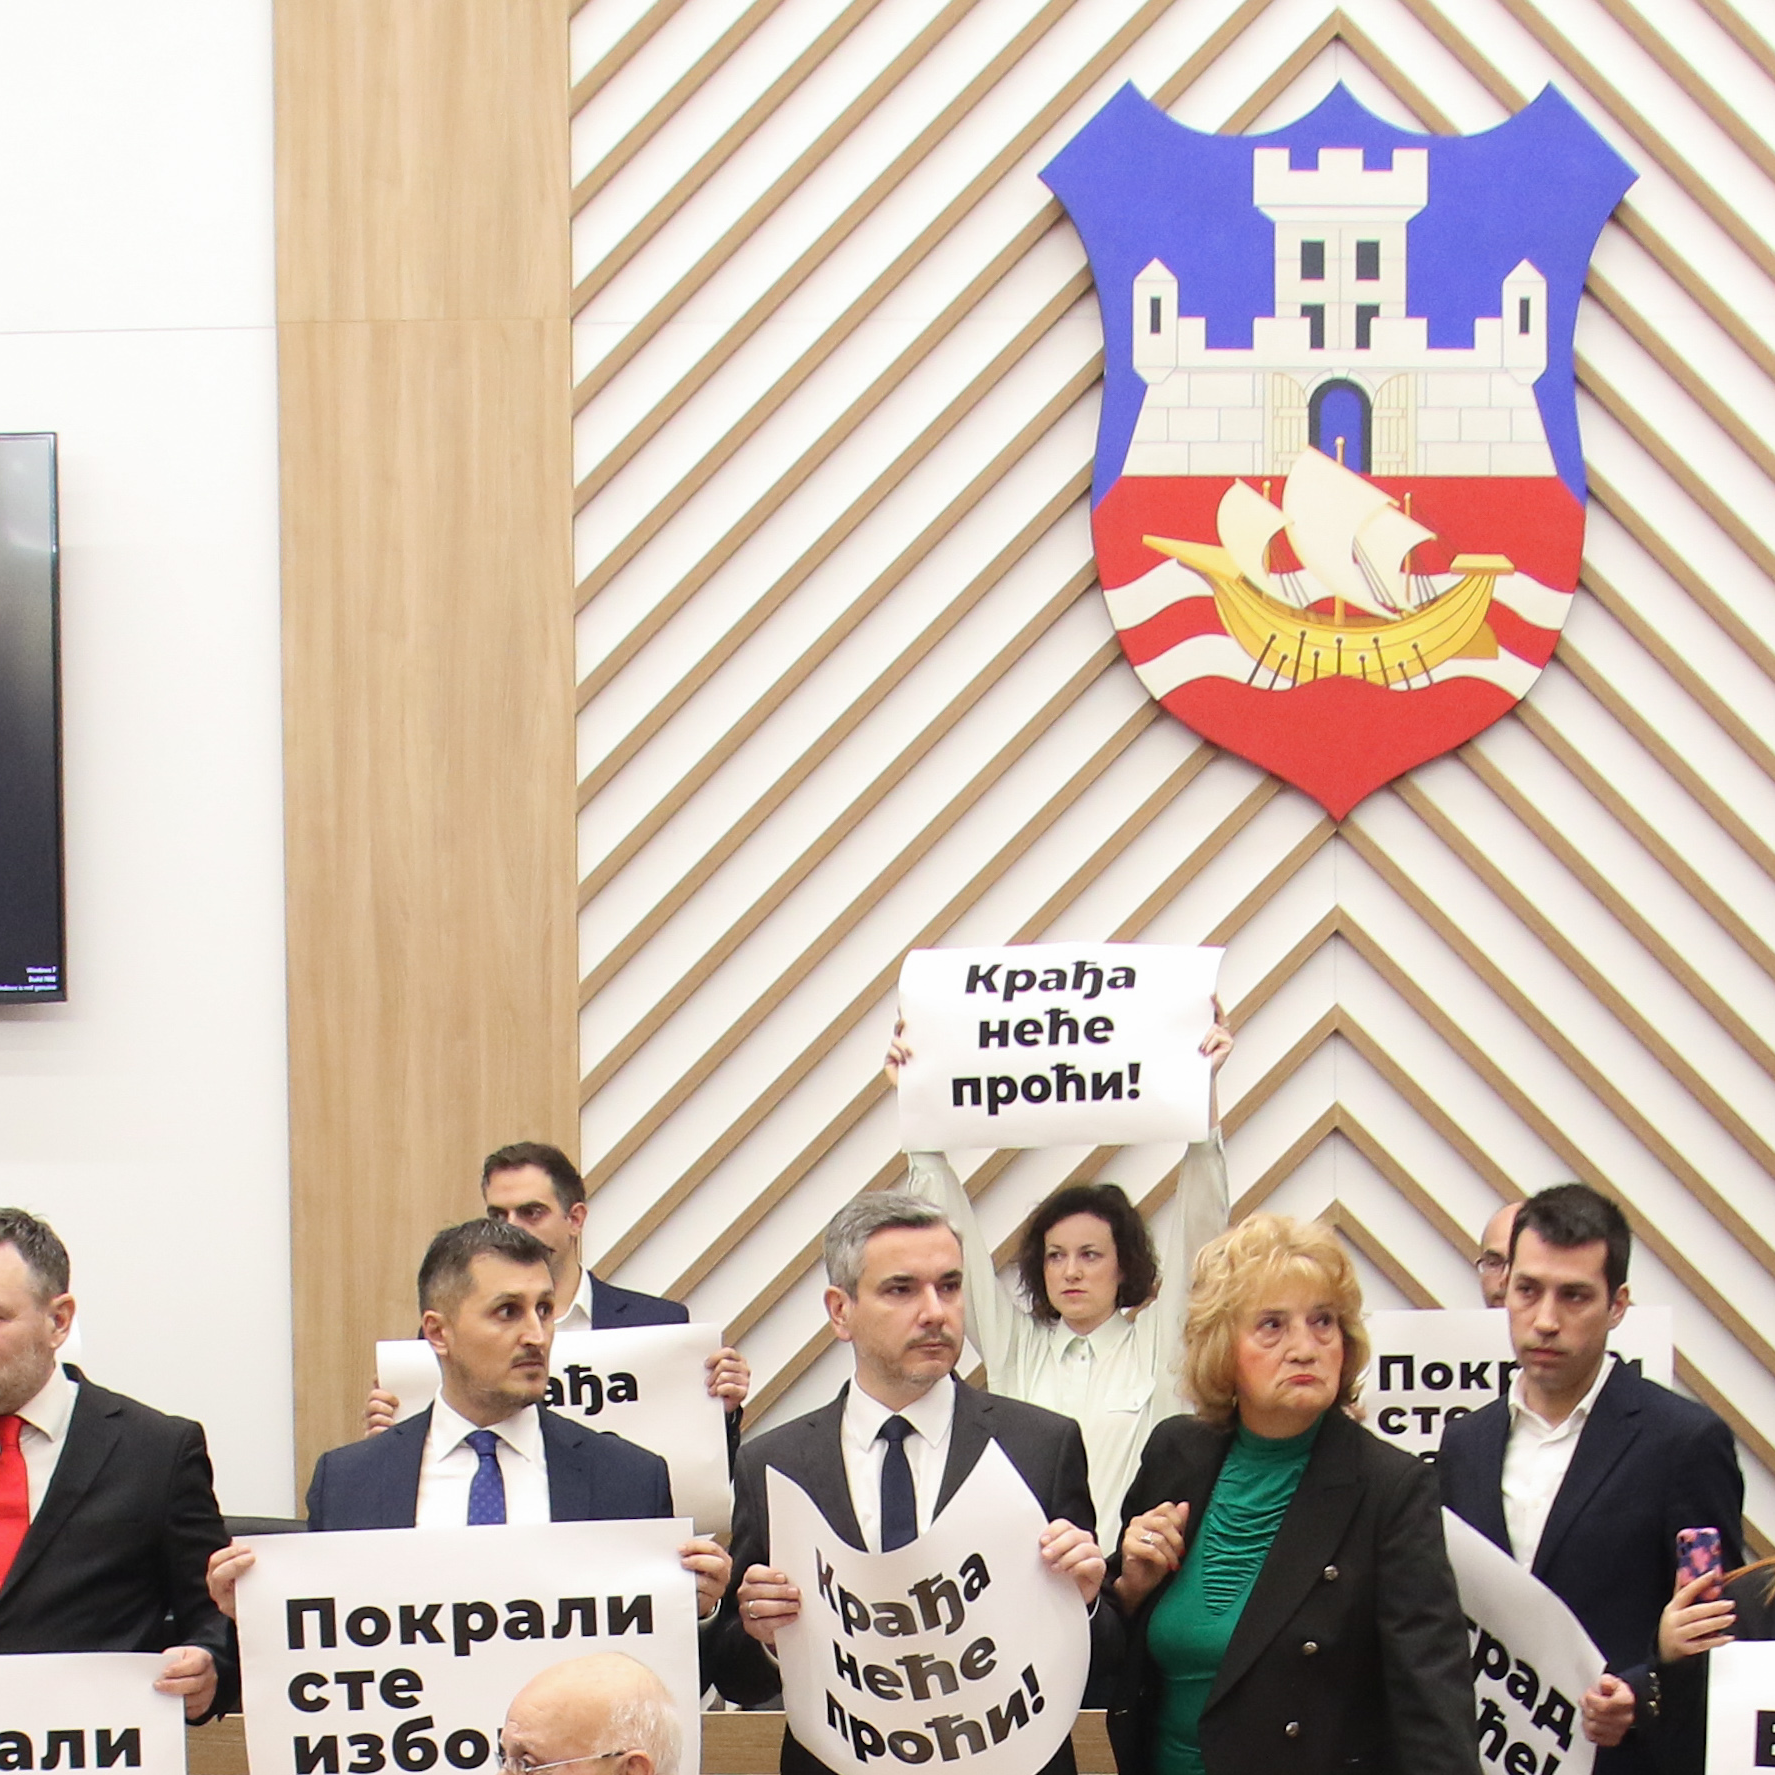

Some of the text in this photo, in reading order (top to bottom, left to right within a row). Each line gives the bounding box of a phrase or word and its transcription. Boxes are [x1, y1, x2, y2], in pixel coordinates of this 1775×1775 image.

[966, 961, 1135, 1000] Крађа
[980, 1009, 1113, 1048] неће
[953, 1063, 1140, 1115] проћи!
[546, 1365, 637, 1415] ађа
[817, 1549, 990, 1637] Крађа
[287, 1595, 653, 1656] Покрали
[288, 1668, 423, 1712] сте
[833, 1637, 996, 1700] неће
[826, 1664, 1044, 1764] проћи!
[294, 1716, 502, 1774] избо
